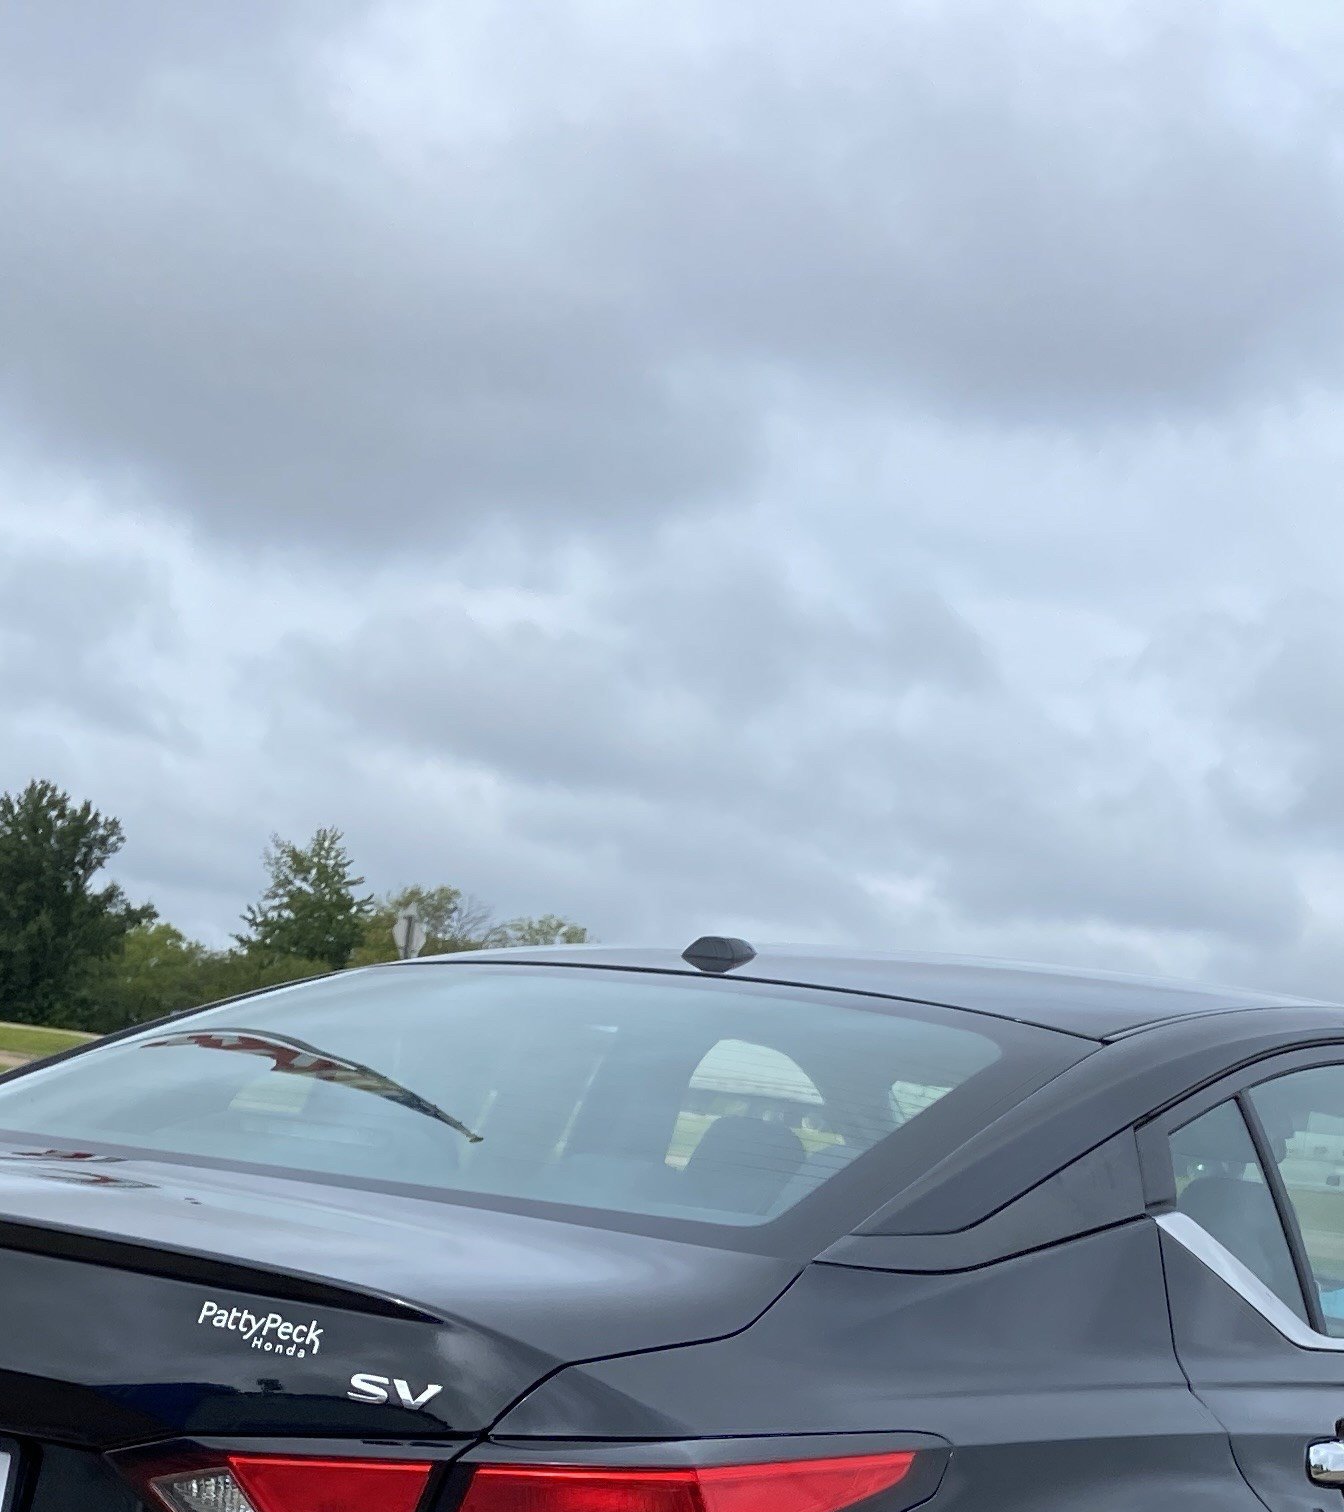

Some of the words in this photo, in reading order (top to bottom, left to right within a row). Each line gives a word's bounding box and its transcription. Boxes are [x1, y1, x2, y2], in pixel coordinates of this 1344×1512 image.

[197, 1300, 324, 1355] PattyPeck
[251, 1336, 306, 1359] Honda
[347, 1373, 444, 1411] SV
